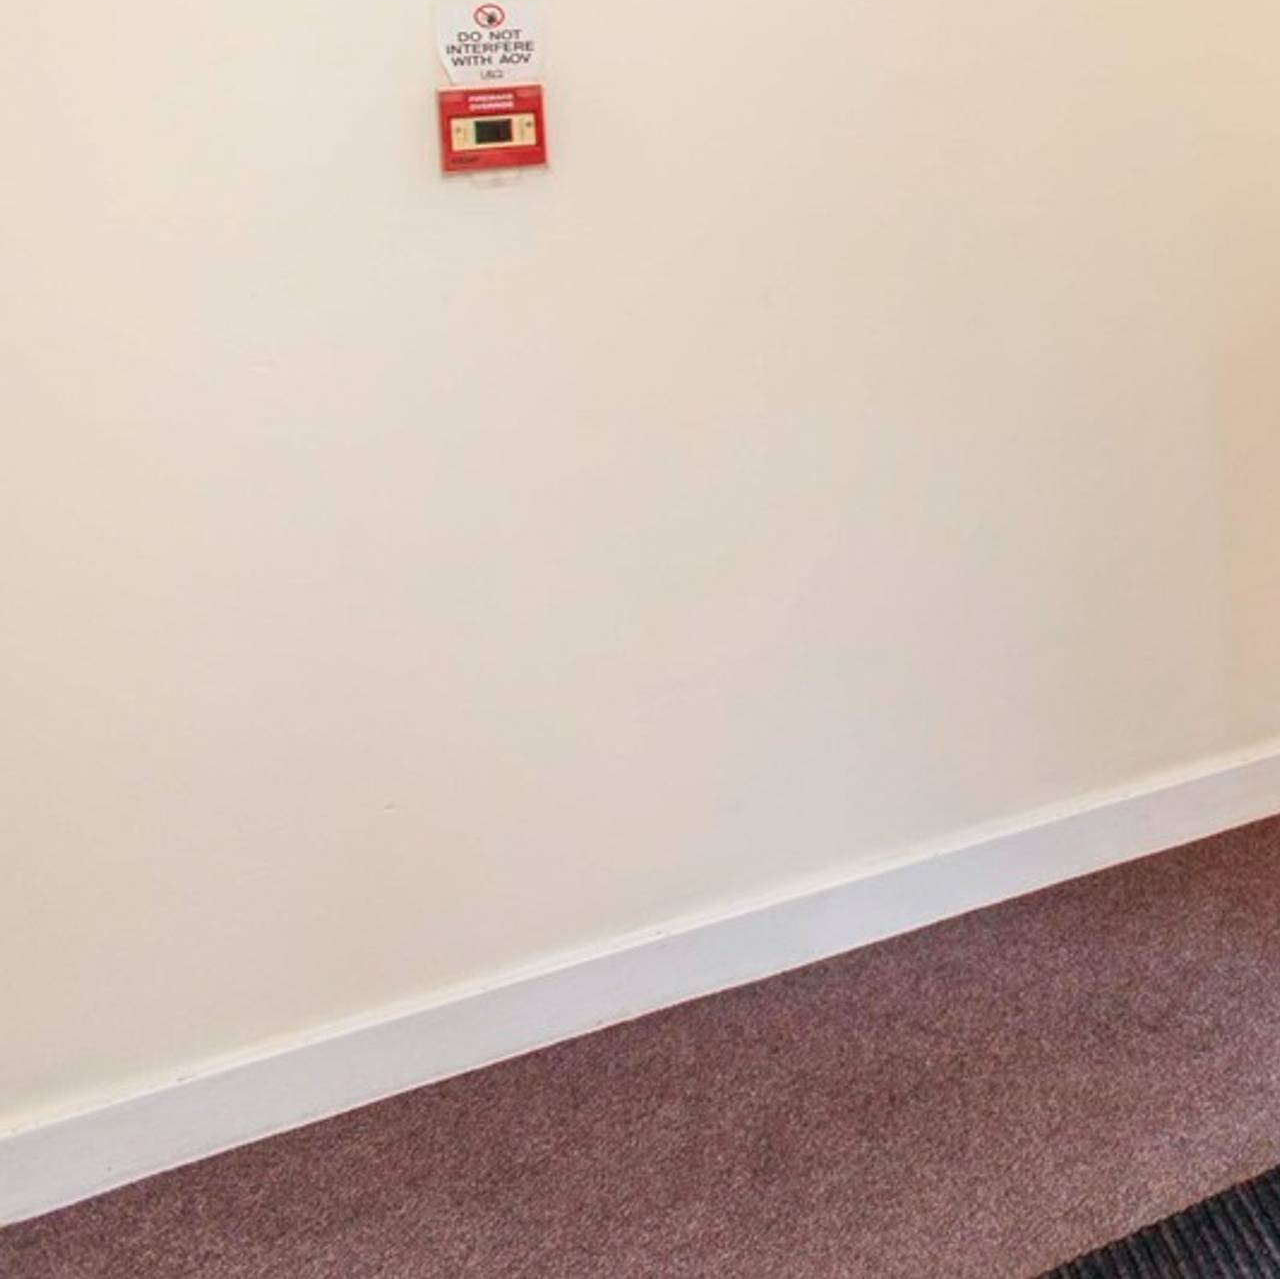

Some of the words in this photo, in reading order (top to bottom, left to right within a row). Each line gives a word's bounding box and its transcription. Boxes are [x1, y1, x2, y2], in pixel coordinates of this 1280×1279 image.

[457, 31, 482, 42] DO
[489, 29, 522, 40] NOT
[446, 41, 535, 55] INTERFERE
[451, 55, 493, 67] WITH
[499, 53, 532, 64] AOV
